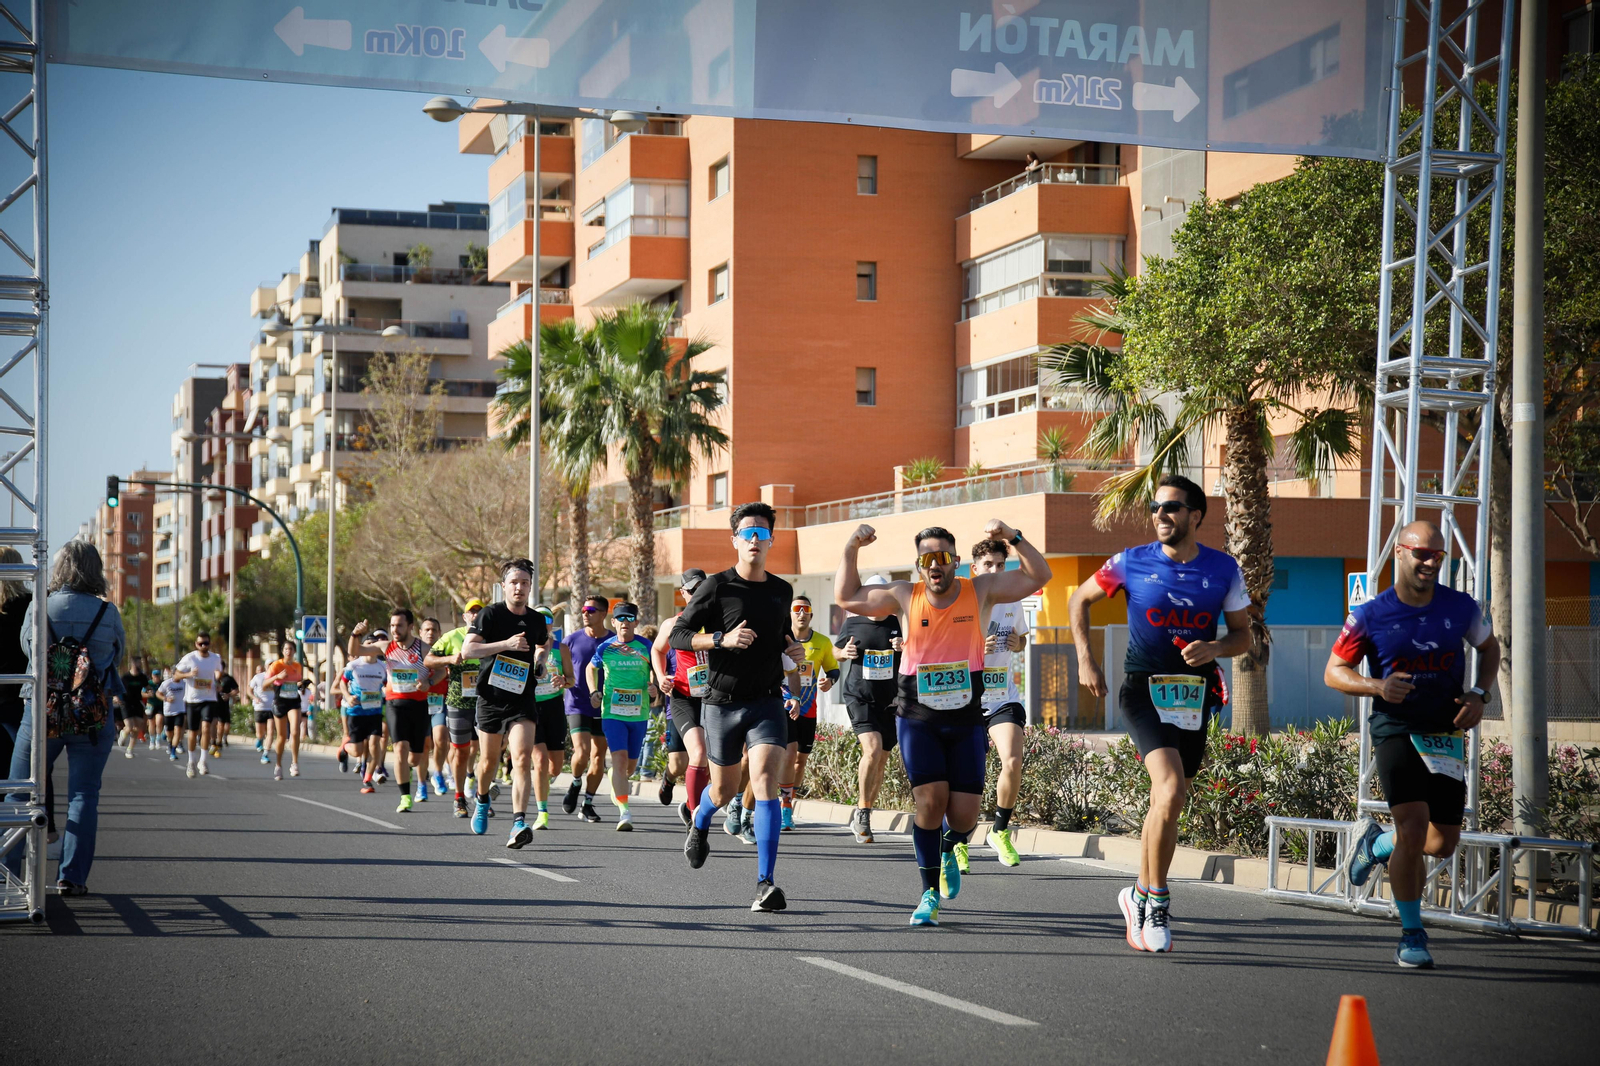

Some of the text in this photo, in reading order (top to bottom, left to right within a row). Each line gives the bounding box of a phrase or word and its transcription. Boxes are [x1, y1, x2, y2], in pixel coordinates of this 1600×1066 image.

[1146, 608, 1212, 628] GALO
[867, 655, 890, 665] 1089
[397, 672, 413, 680] 697
[499, 662, 525, 677] 1065
[924, 669, 965, 687] 1233
[618, 694, 637, 702] 290
[1158, 685, 1199, 701] 1104
[1422, 735, 1455, 751] 584
